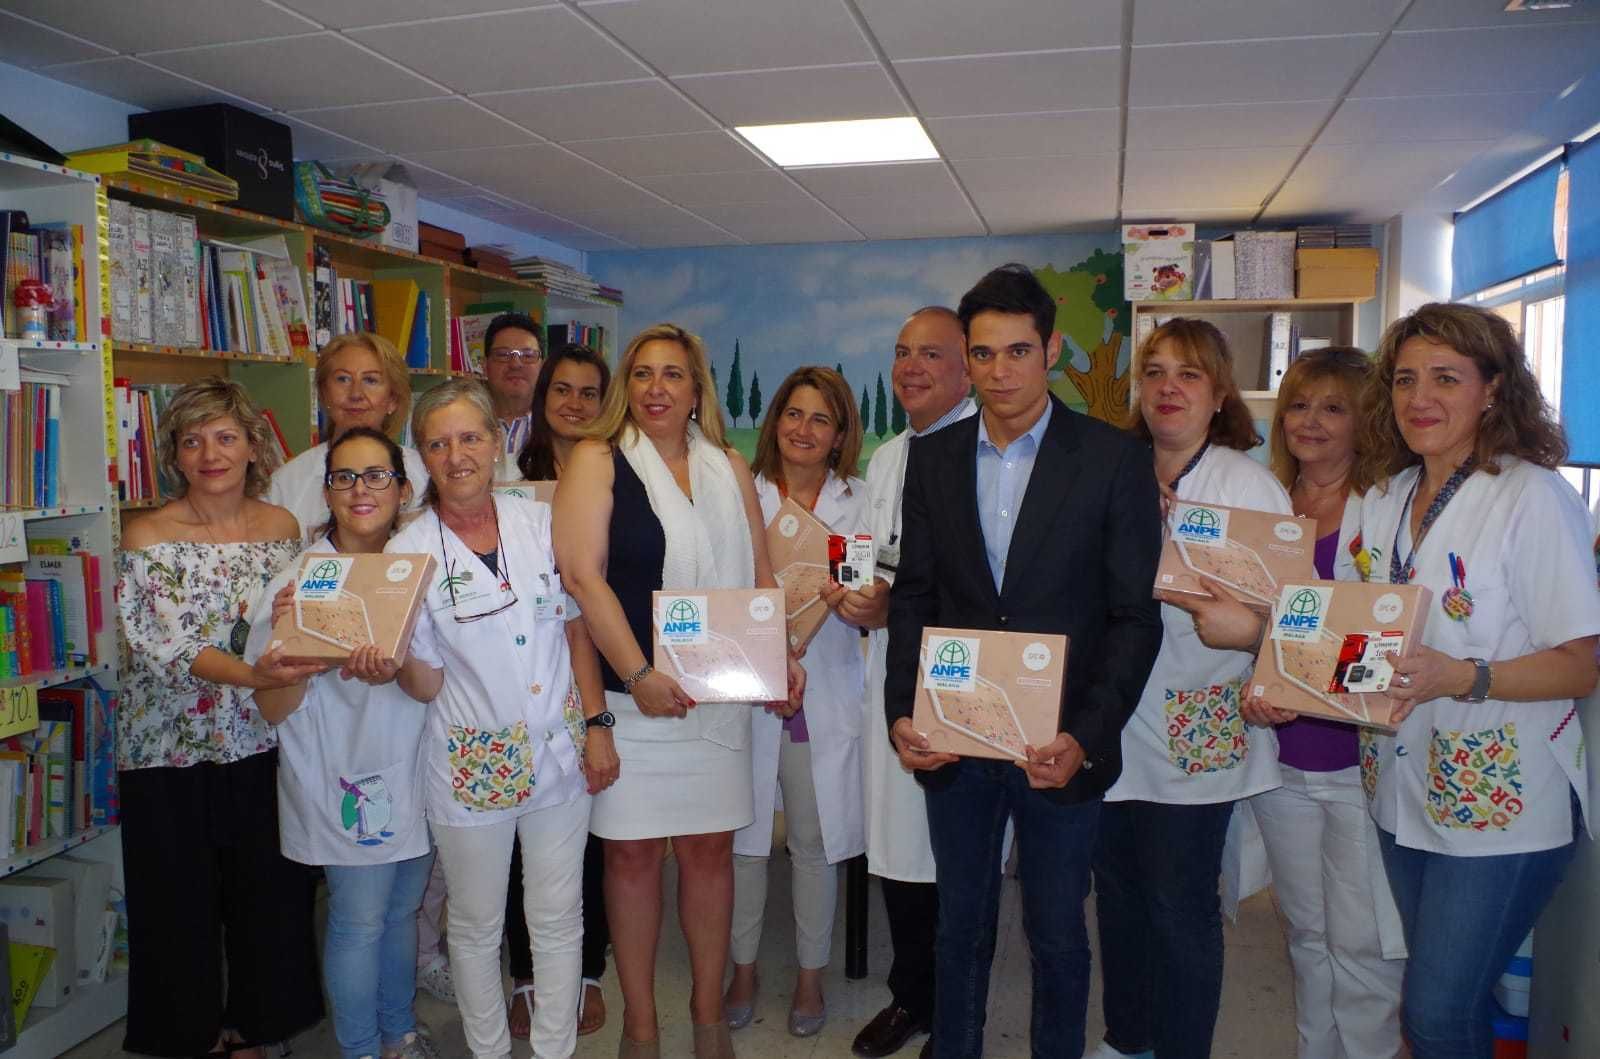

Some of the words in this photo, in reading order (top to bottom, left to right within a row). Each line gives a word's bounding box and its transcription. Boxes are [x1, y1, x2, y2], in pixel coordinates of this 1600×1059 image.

[1177, 523, 1222, 537] ANPE
[302, 580, 338, 590] ANPE
[663, 621, 702, 632] ANPE
[1279, 614, 1319, 627] ANPE
[930, 664, 971, 677] ANPE
